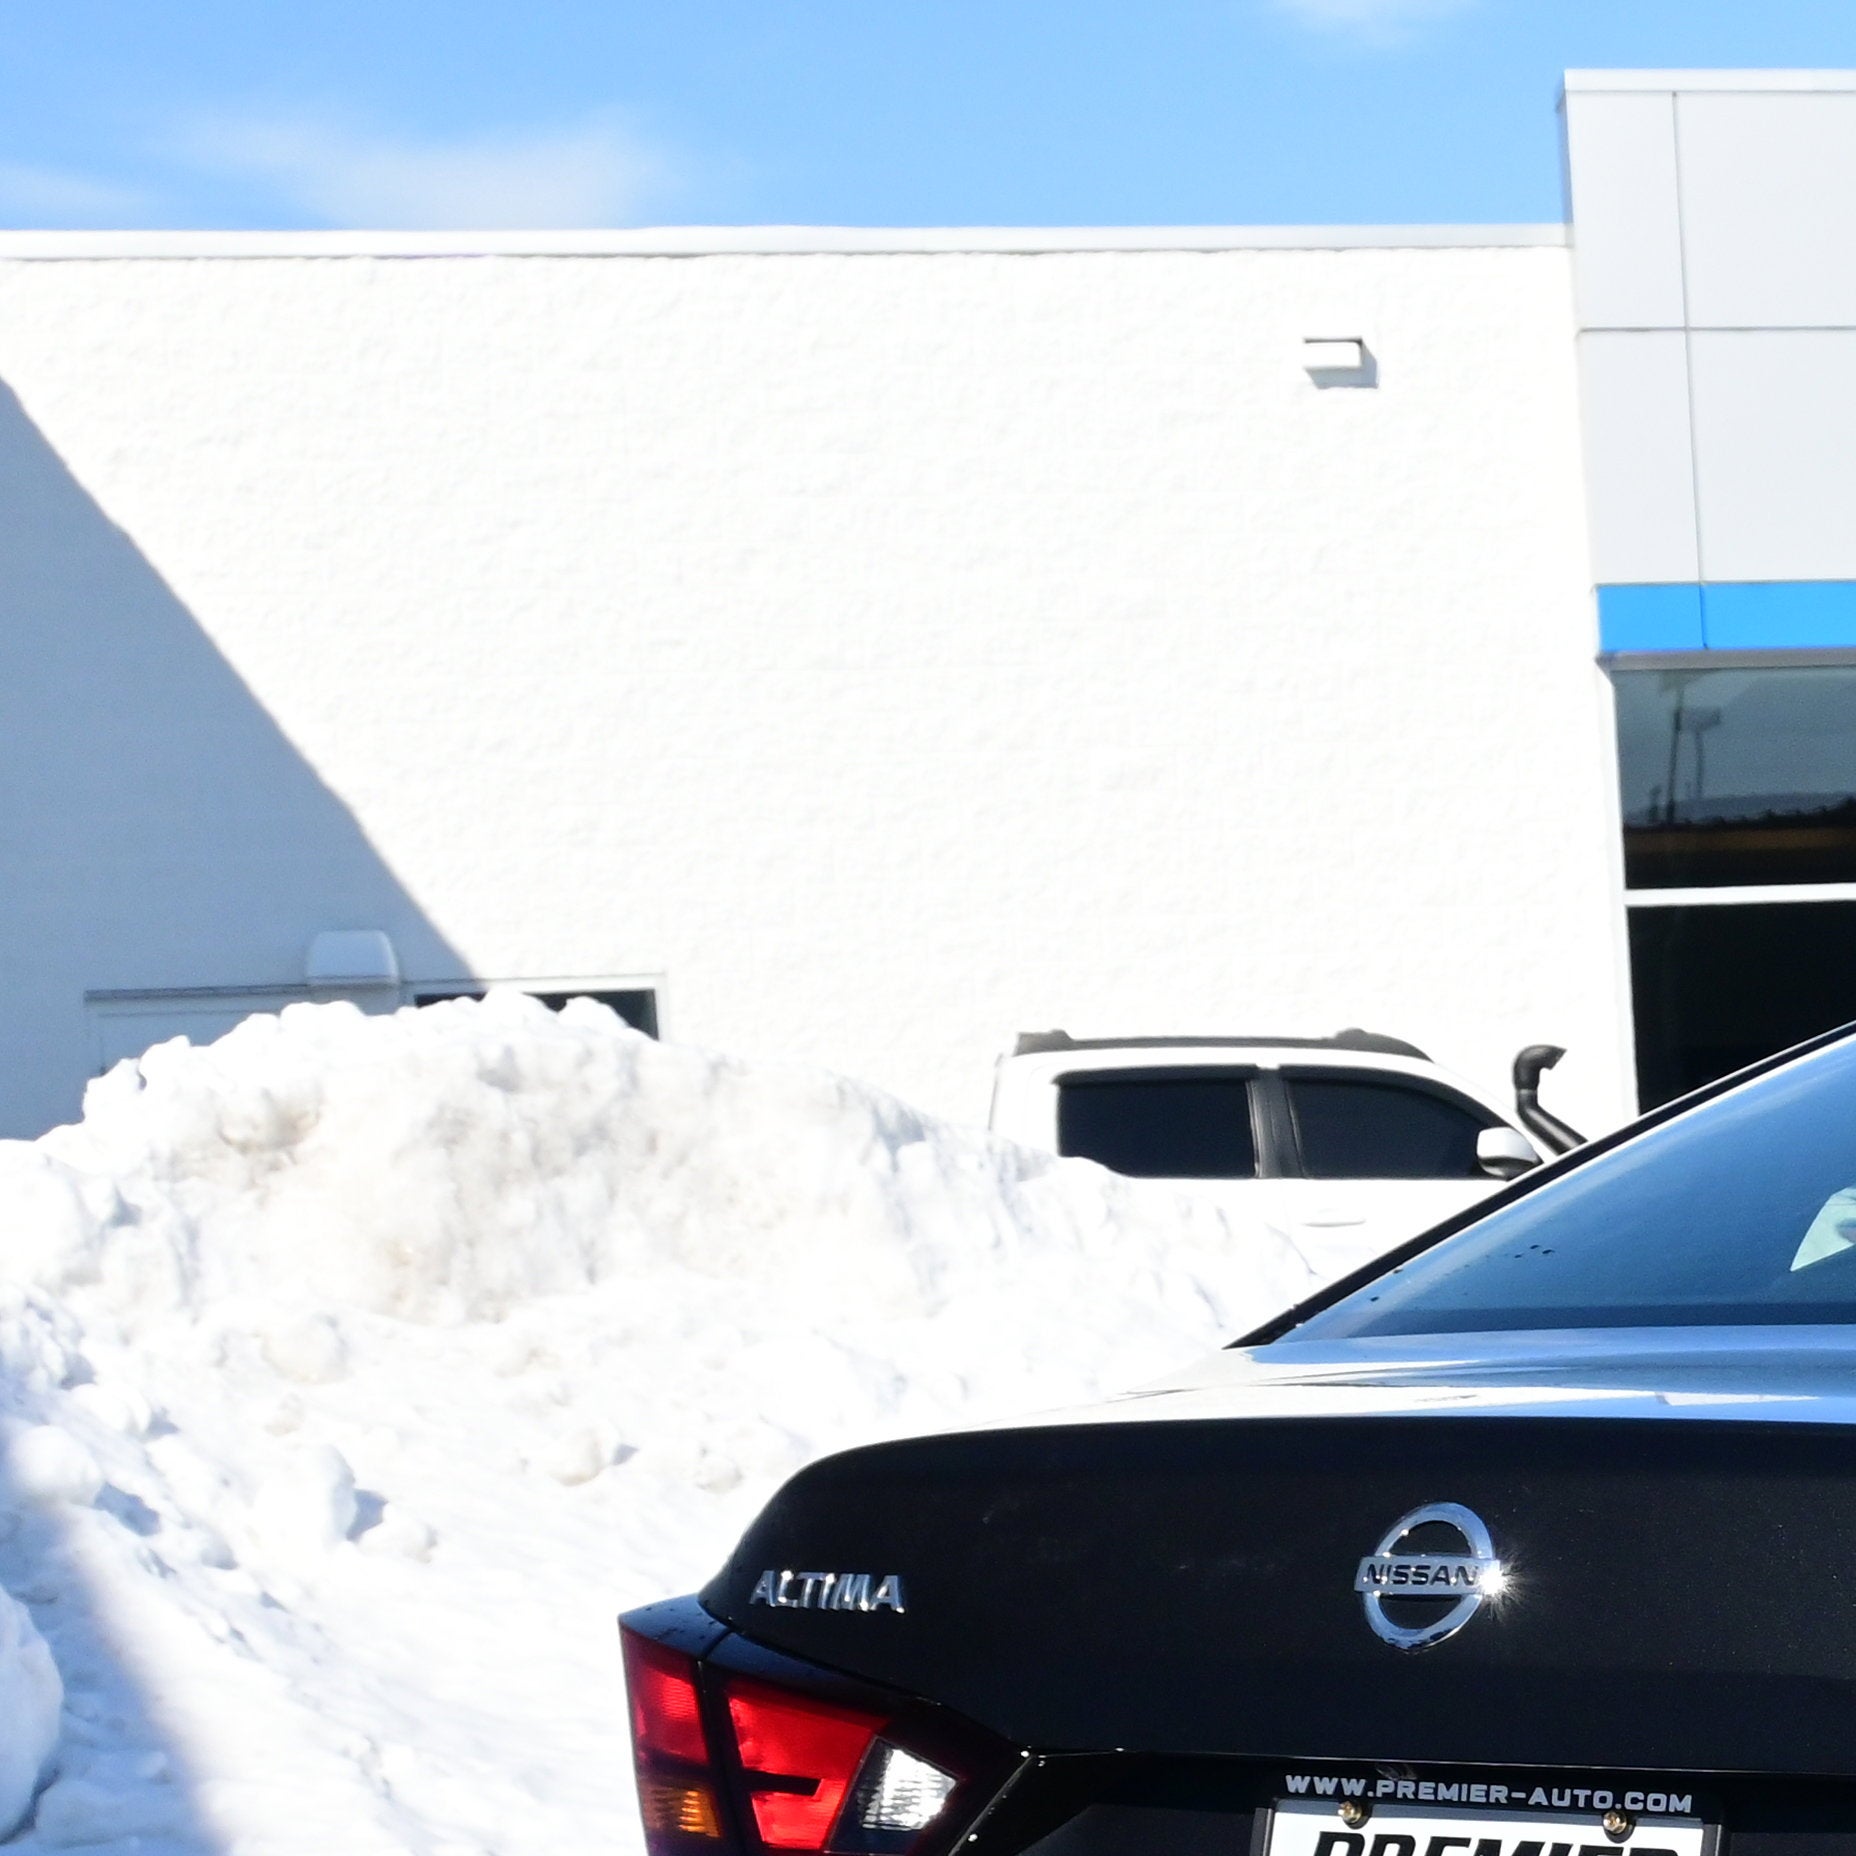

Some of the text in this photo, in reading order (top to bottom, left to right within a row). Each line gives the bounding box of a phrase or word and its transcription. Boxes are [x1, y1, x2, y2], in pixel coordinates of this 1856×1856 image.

[749, 1570, 905, 1613] ALTIMA
[1367, 1563, 1479, 1586] NISSAN
[1285, 1774, 1693, 1813] WWW.PREMIER-AUTO.COM
